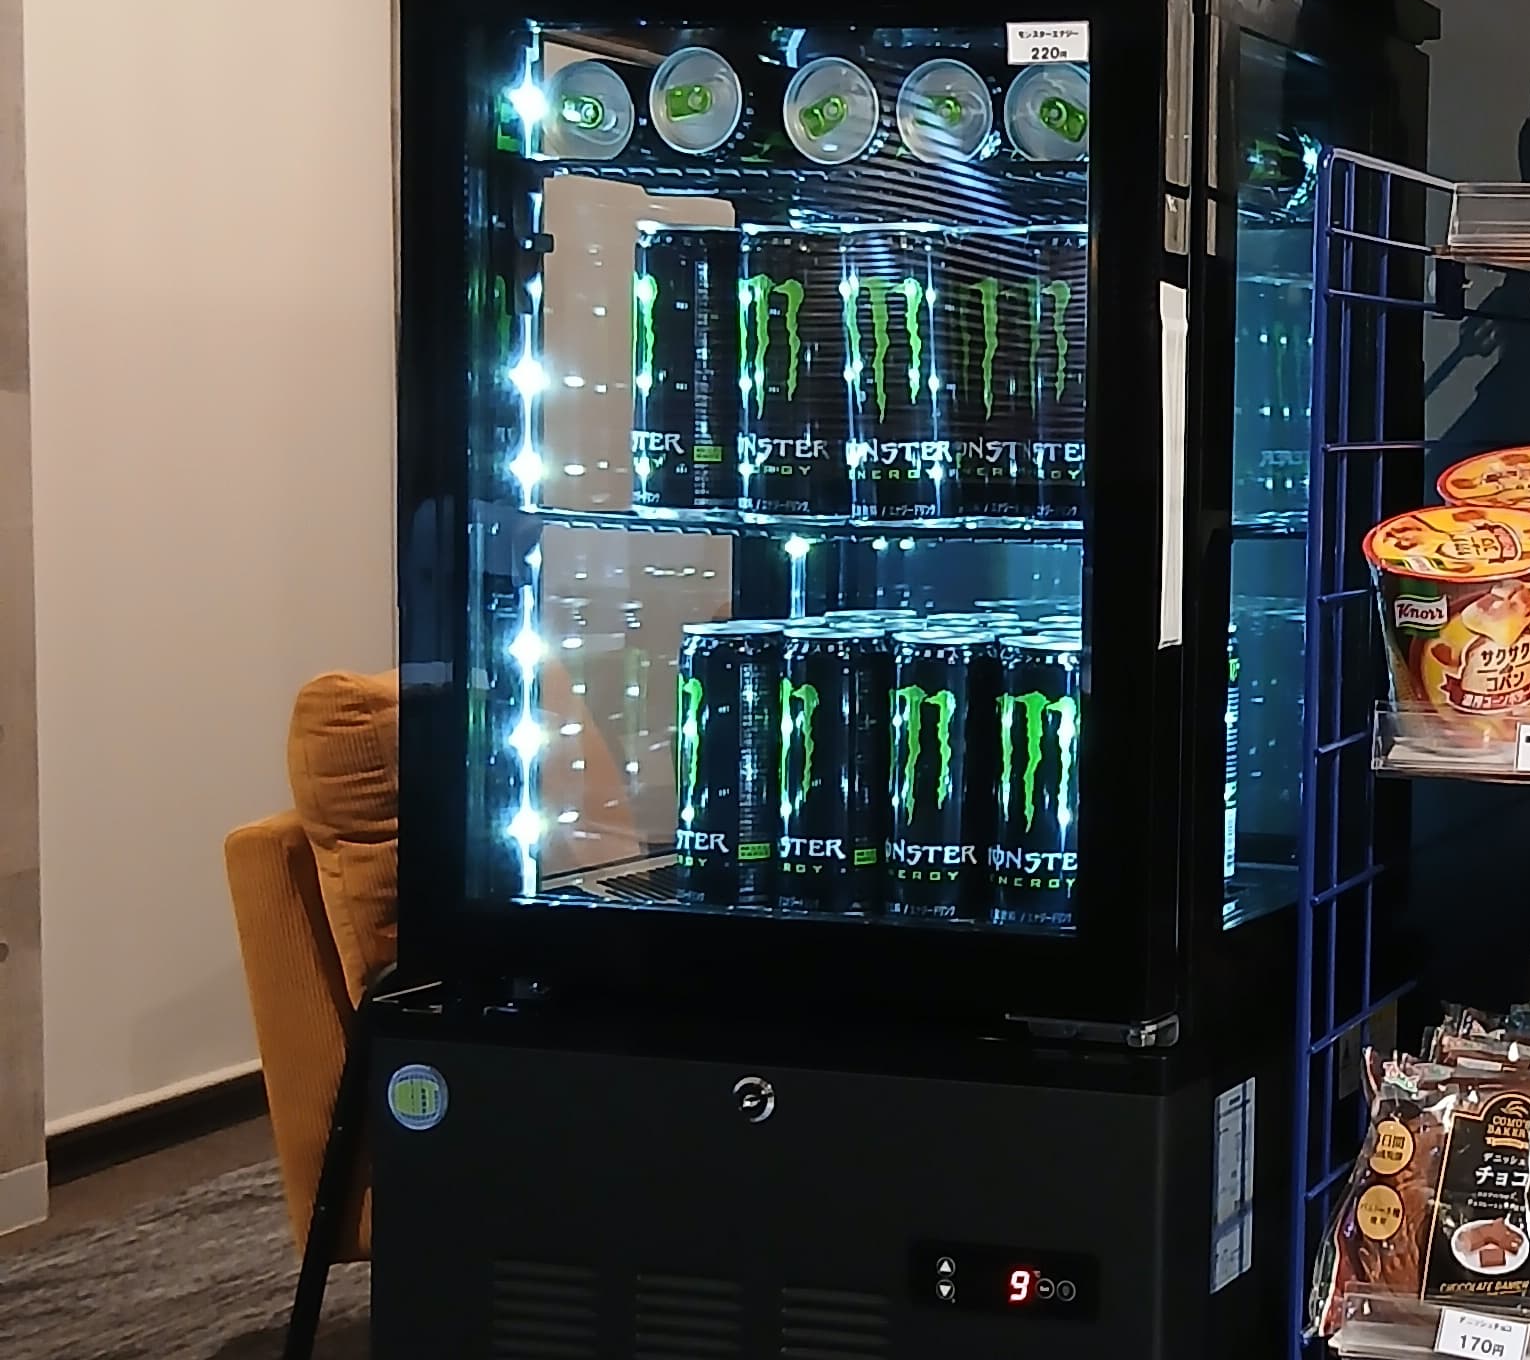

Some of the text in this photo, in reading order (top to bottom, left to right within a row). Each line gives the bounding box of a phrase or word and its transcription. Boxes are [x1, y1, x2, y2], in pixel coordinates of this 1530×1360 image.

[1031, 46, 1068, 60] 220円
[1396, 603, 1446, 622] Knorr
[1480, 642, 1530, 667] サクサク
[1487, 1126, 1528, 1139] BAKER
[1475, 1166, 1530, 1187] チョコ
[1009, 1270, 1031, 1302] 9
[1460, 1333, 1505, 1358] 170円
